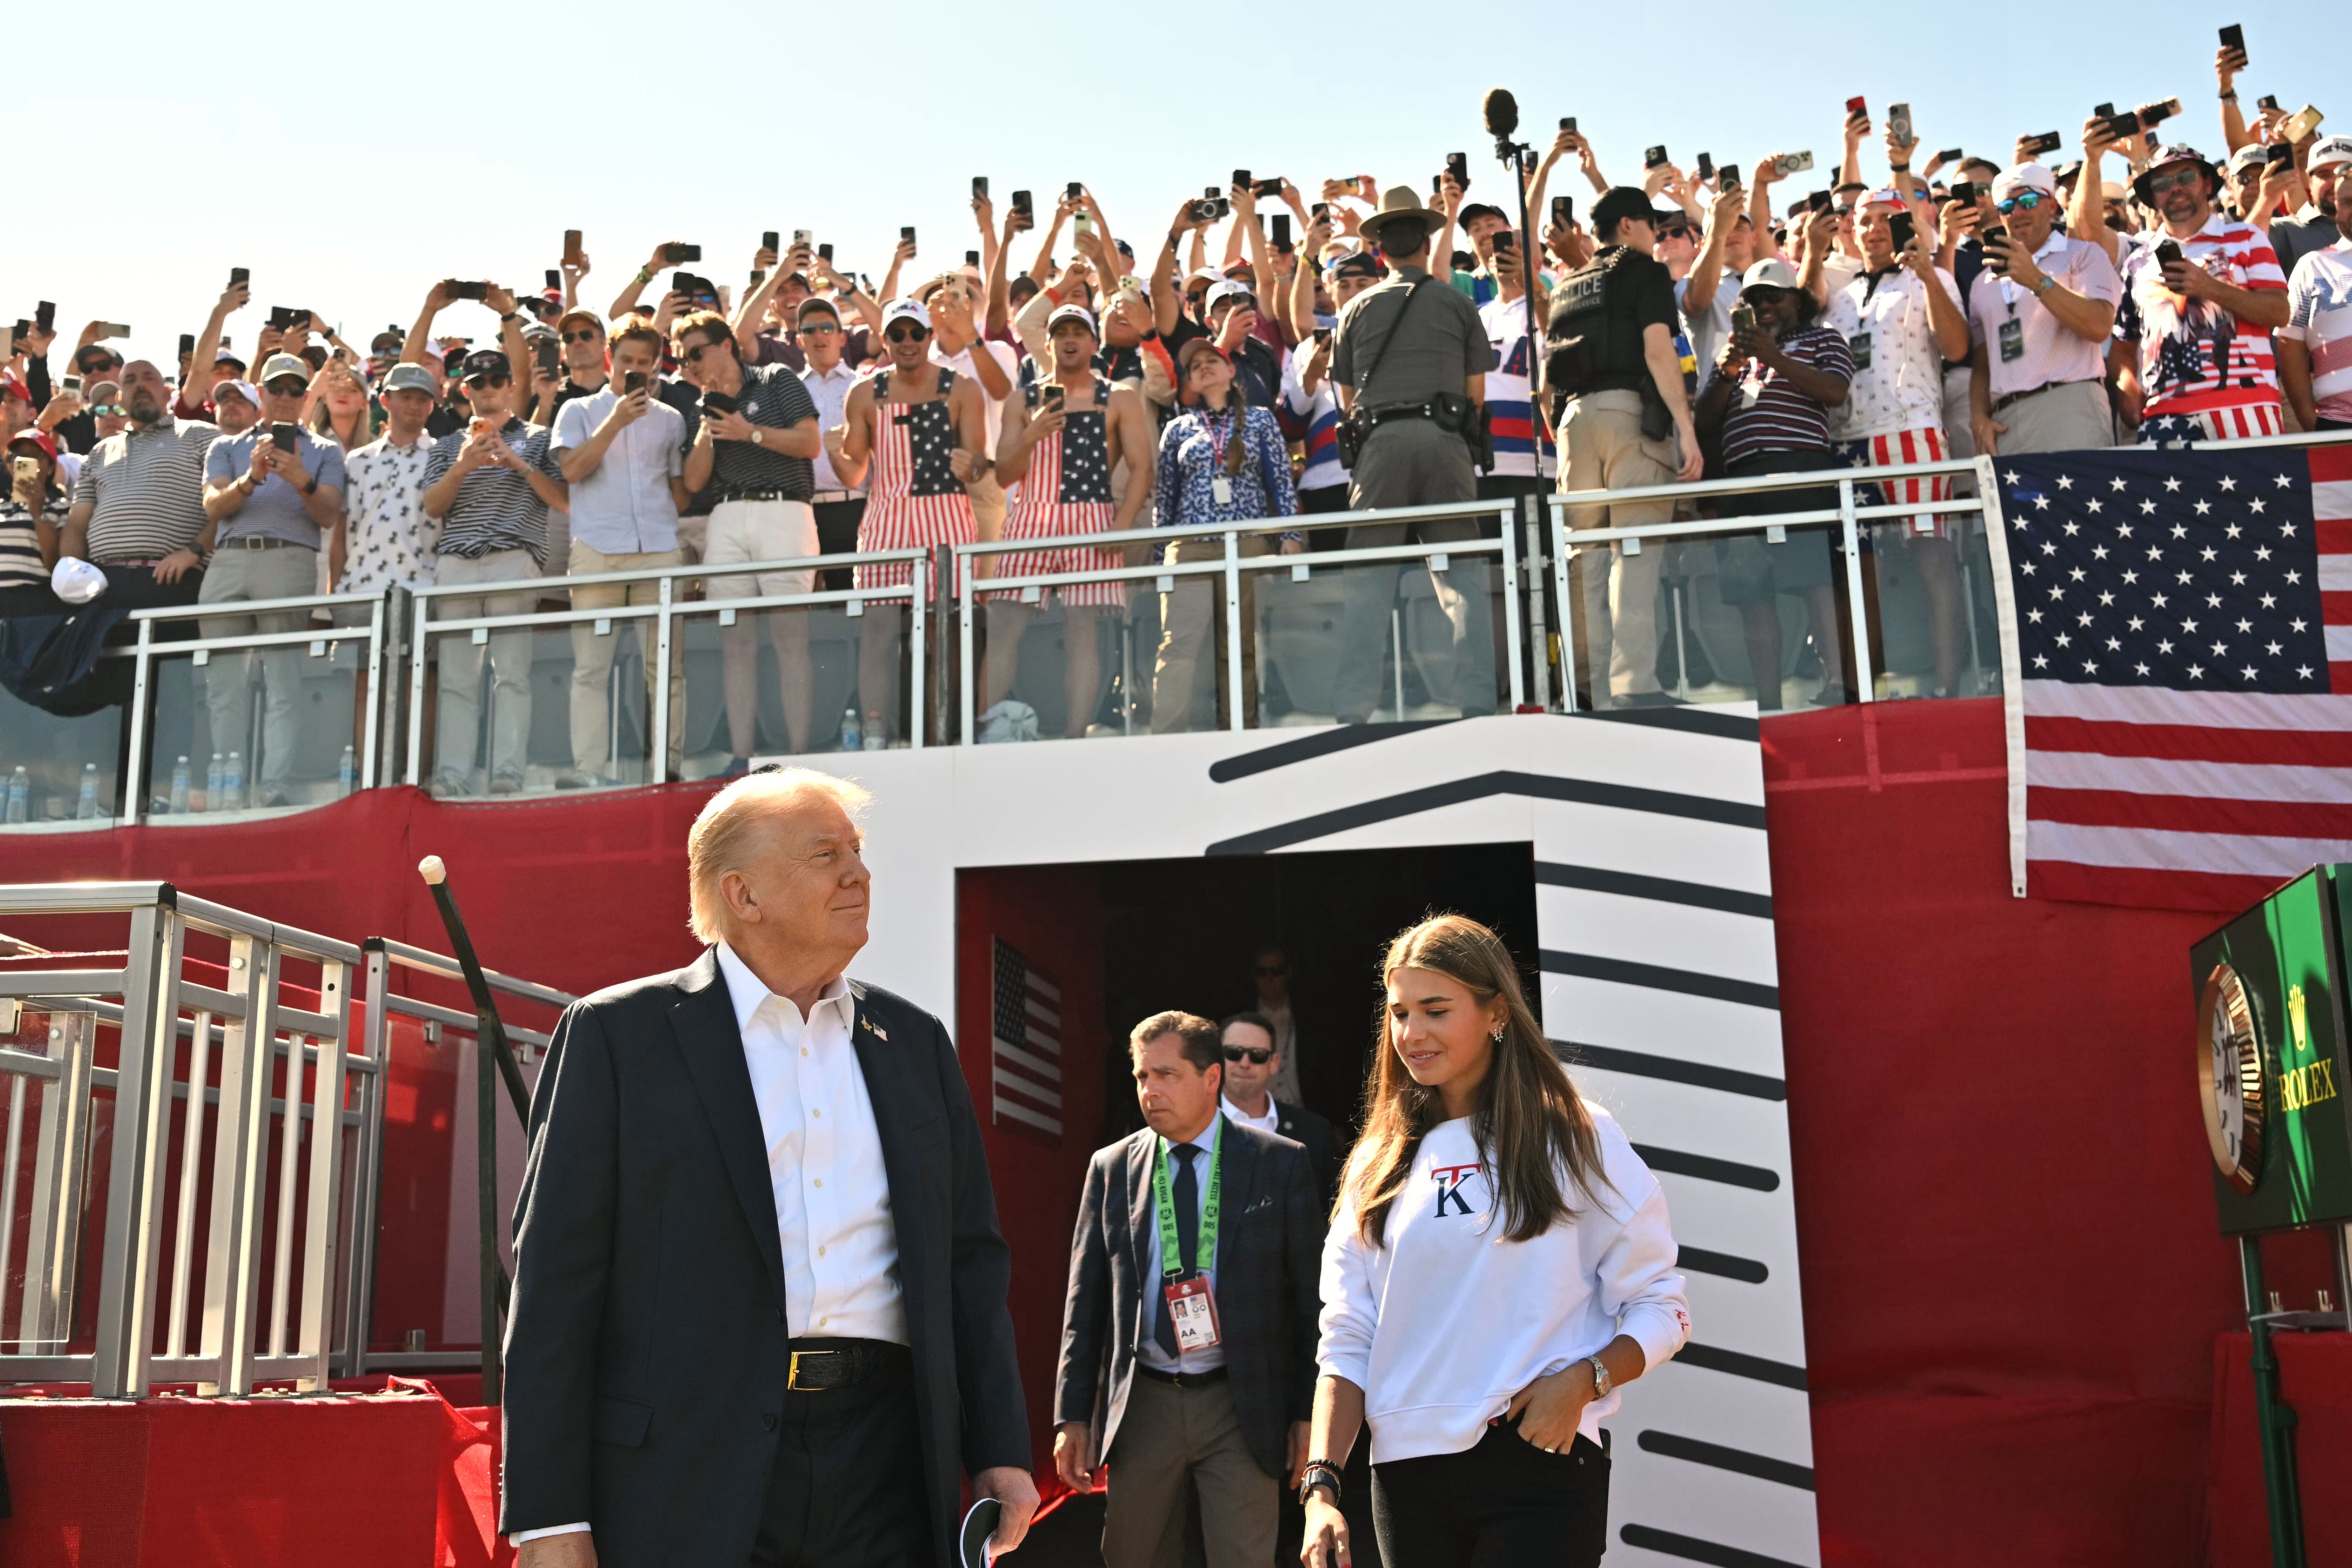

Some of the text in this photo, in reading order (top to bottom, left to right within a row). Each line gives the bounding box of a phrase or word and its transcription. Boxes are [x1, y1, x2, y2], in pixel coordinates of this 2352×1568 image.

[2278, 1058, 2337, 1112] ROLEX
[1159, 1186, 1168, 1204] RYDER
[1209, 1181, 1219, 1200] ACCESS
[1181, 1328, 1196, 1338] AA
